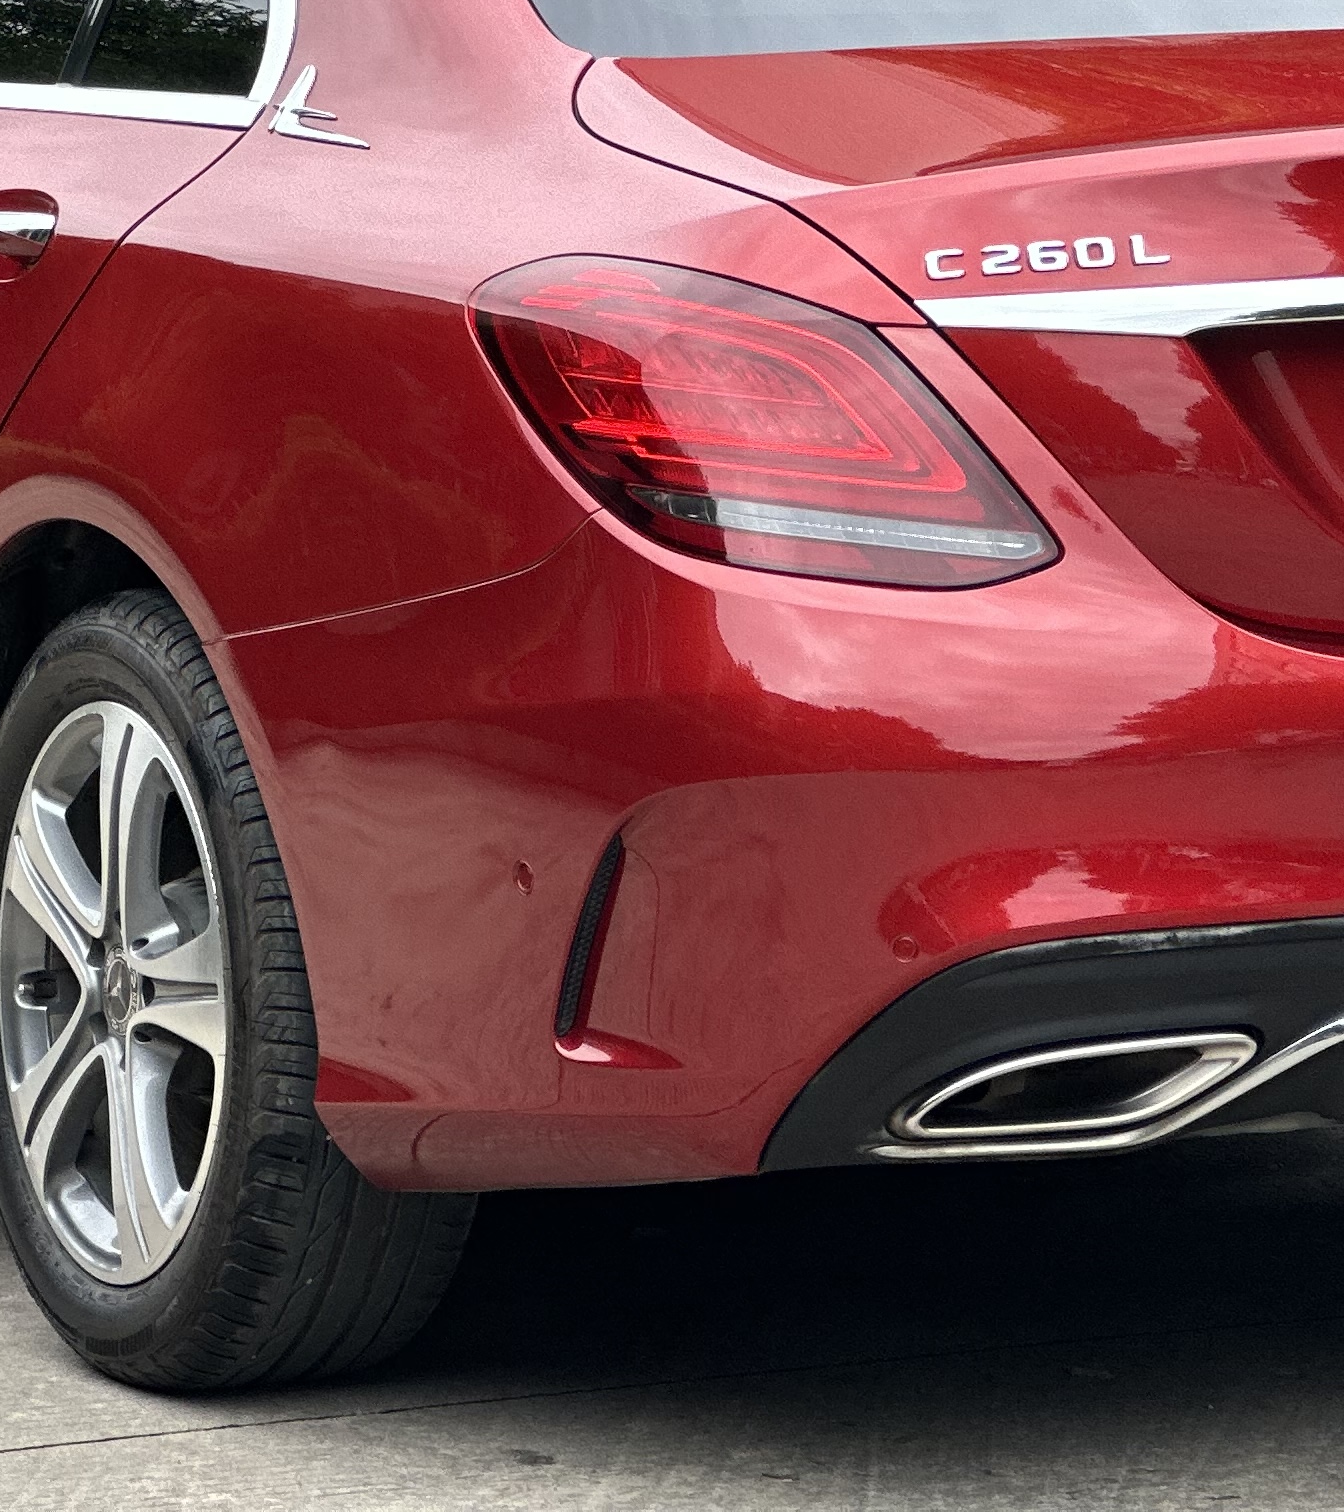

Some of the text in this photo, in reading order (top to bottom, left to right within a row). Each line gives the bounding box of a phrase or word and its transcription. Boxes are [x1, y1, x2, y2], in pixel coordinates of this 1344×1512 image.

[924, 233, 1172, 281] C 260 L
